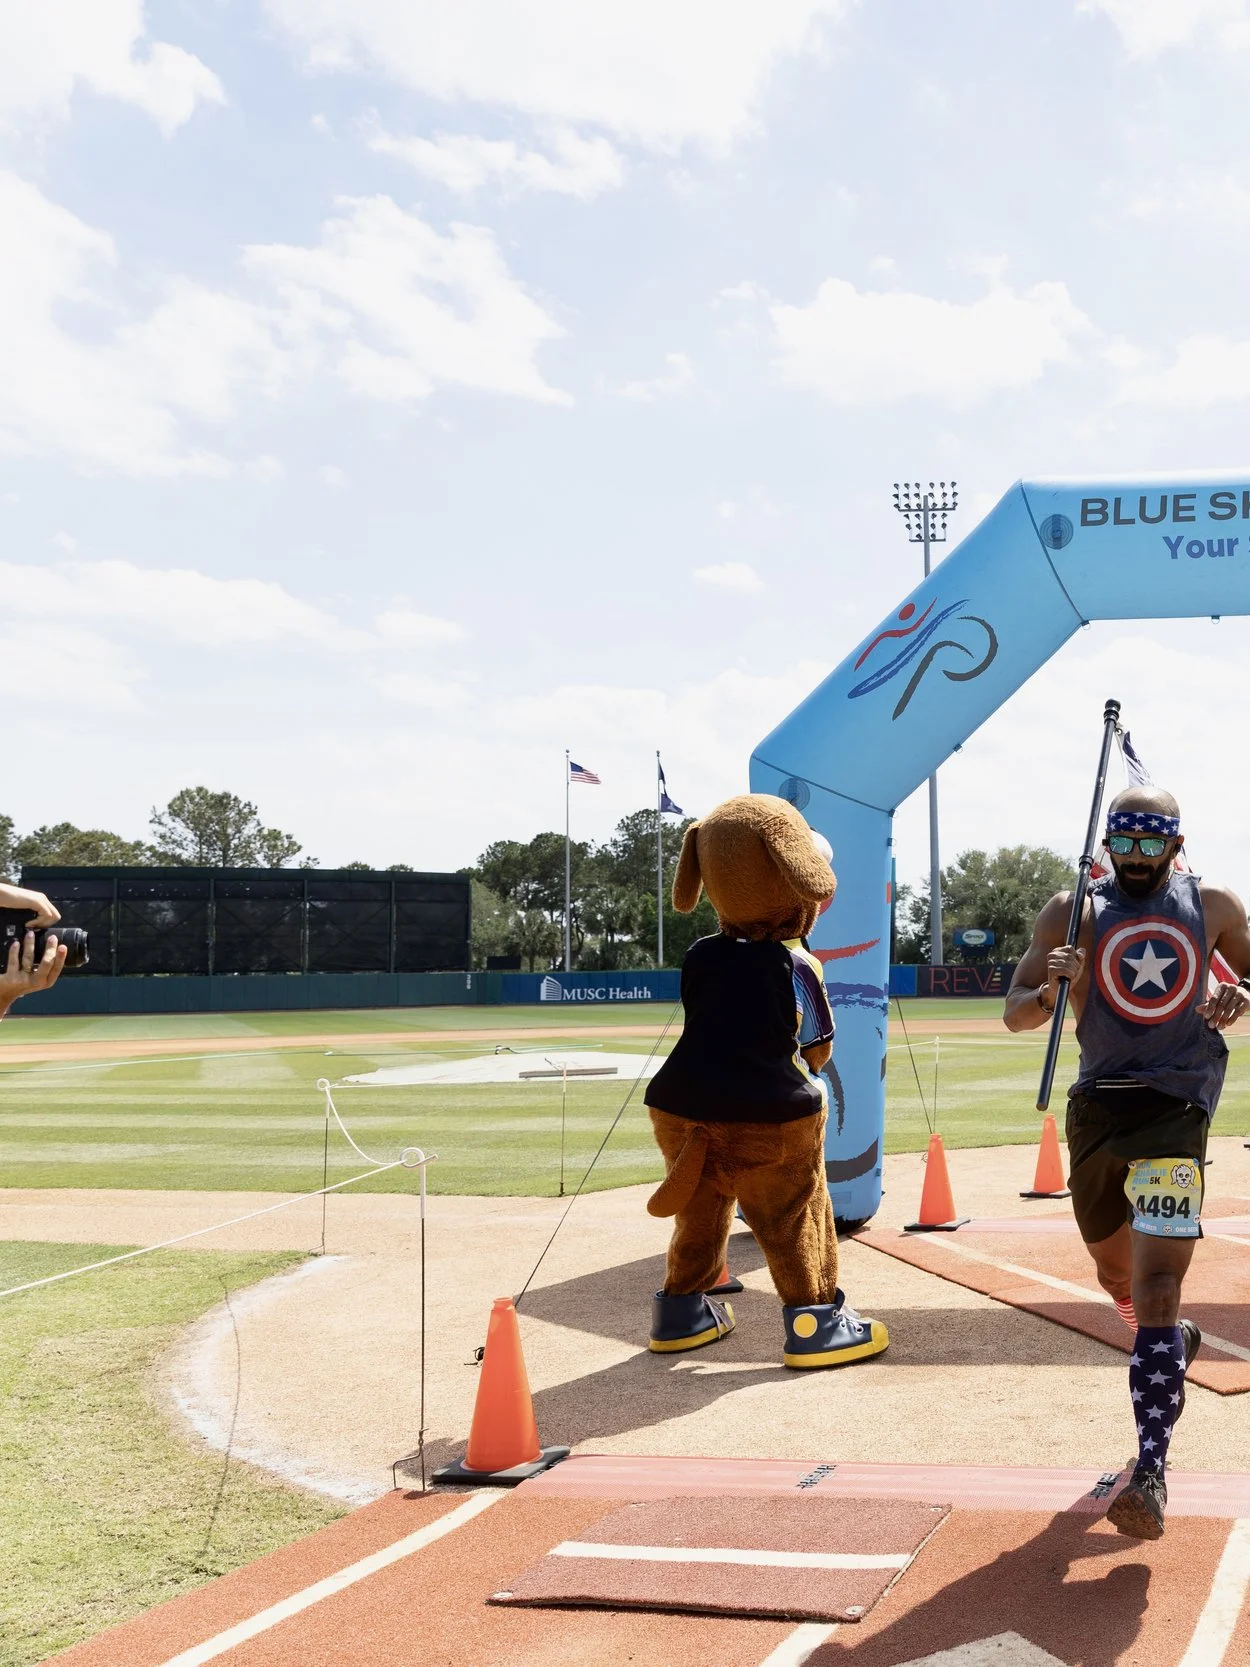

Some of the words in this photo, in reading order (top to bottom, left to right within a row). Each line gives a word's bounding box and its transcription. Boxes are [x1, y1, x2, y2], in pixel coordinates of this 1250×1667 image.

[1080, 493, 1197, 527] BLUE
[1162, 535, 1239, 560] Your
[562, 987, 606, 1001] MUSC
[608, 986, 652, 1000] Health
[1149, 1176, 1161, 1185] 5K
[1136, 1194, 1191, 1219] 4494
